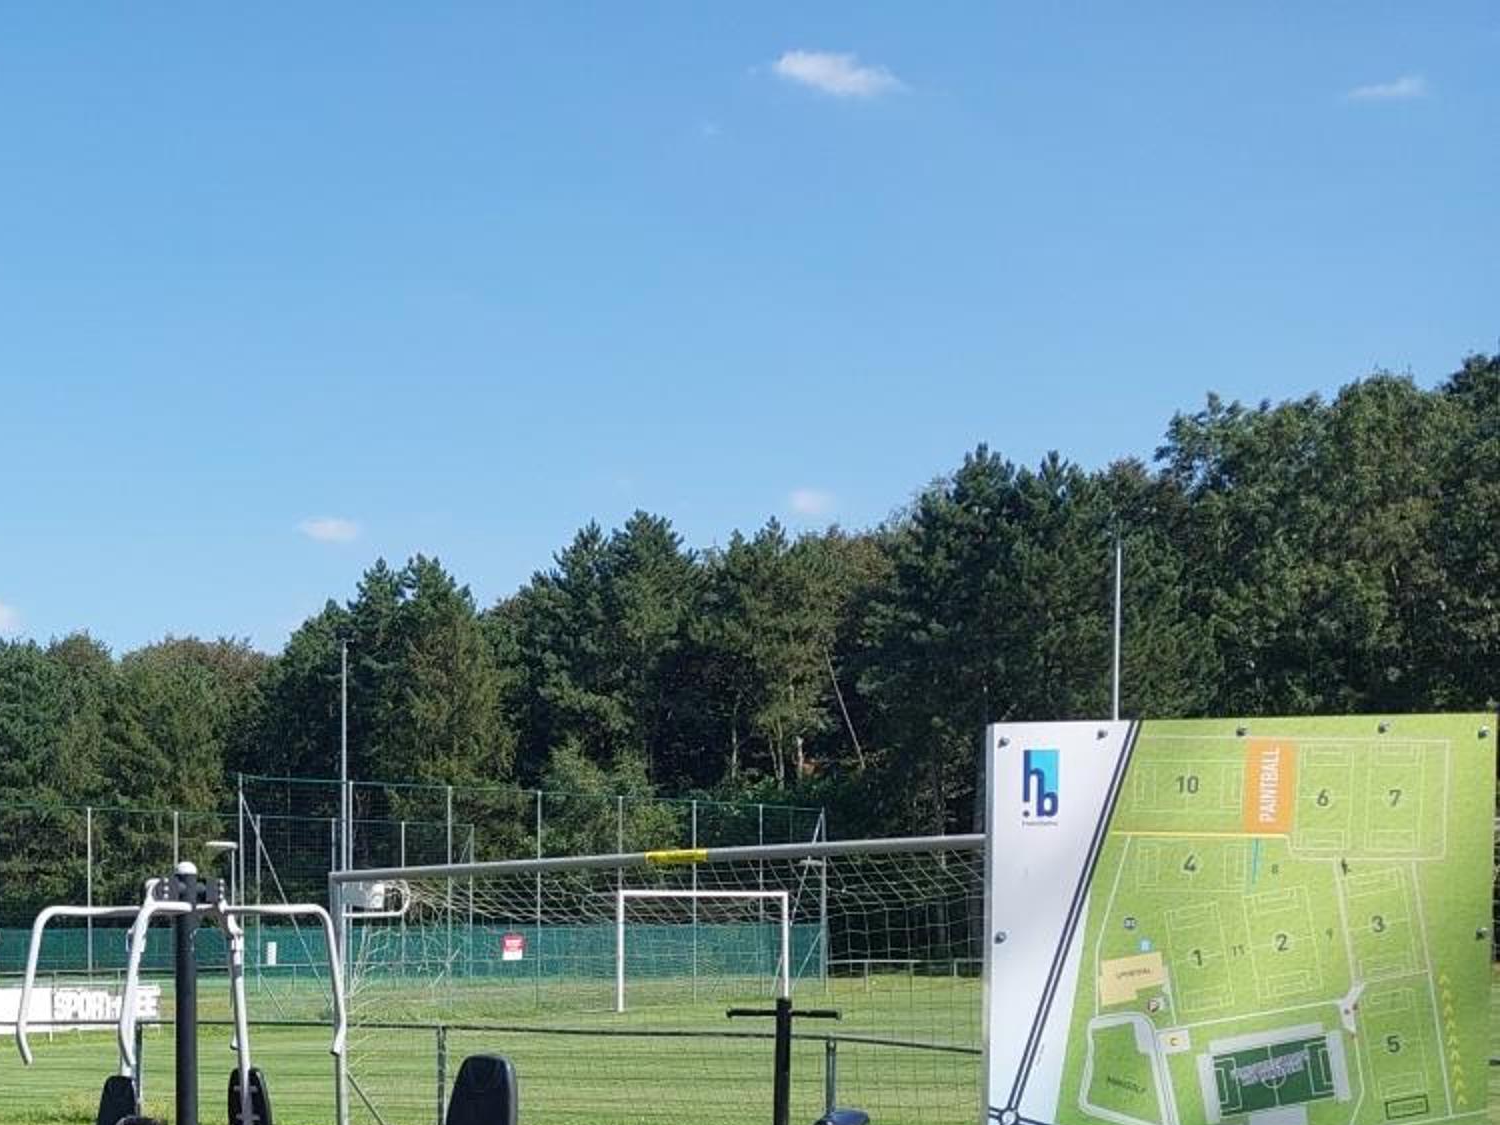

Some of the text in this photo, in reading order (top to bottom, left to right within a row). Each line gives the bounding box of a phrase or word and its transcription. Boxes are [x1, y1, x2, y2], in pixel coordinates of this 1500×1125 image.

[1177, 775, 1199, 794] 10
[1259, 747, 1280, 823] PAINTBALL
[1316, 788, 1329, 807] 6
[1388, 789, 1402, 807] 7
[1183, 855, 1197, 872] 4
[1371, 915, 1385, 933] 3
[1275, 933, 1288, 951] 2
[1192, 949, 1202, 966] 1
[1387, 1036, 1400, 1053] 5
